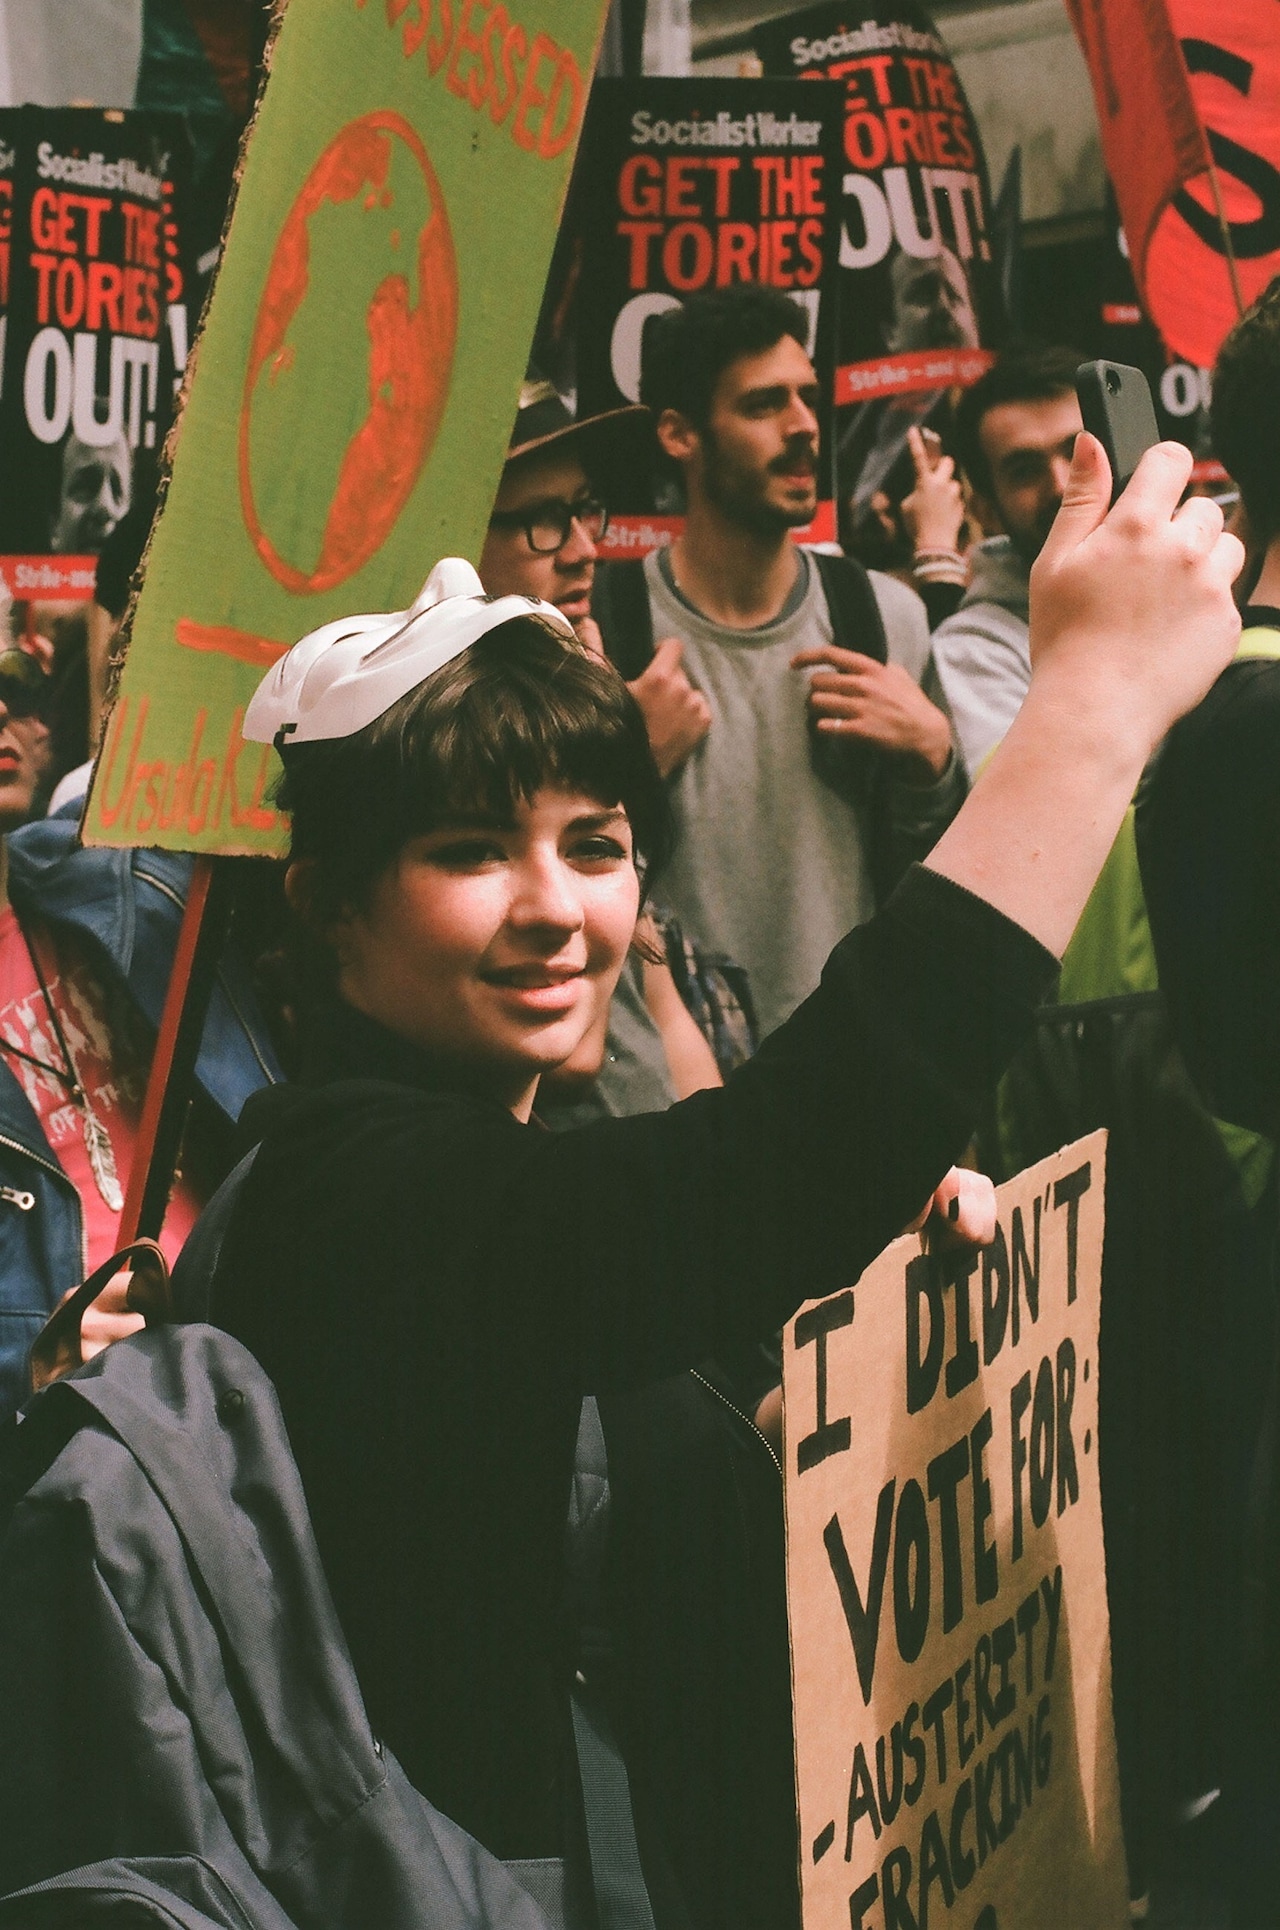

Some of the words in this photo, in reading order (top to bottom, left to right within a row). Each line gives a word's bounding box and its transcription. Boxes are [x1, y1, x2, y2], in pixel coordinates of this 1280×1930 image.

[902, 56, 965, 113] THE
[843, 107, 976, 170] ORIES
[30, 186, 112, 258] GET
[120, 202, 161, 269] THE
[616, 154, 741, 219] GET
[751, 155, 826, 218] THE
[838, 165, 991, 270] OUT!
[30, 252, 161, 340] TORIES
[615, 220, 824, 291] TORIES
[24, 326, 160, 449] OUT!
[603, 524, 671, 548] Strike
[794, 1290, 855, 1478] I
[905, 1161, 1091, 1416] DIDN'T
[823, 1406, 999, 1707] VOTE
[1010, 1337, 1092, 1564] FOR:
[844, 1564, 1063, 1864] AUSTERITY
[849, 1693, 1053, 1930] FRACKING
